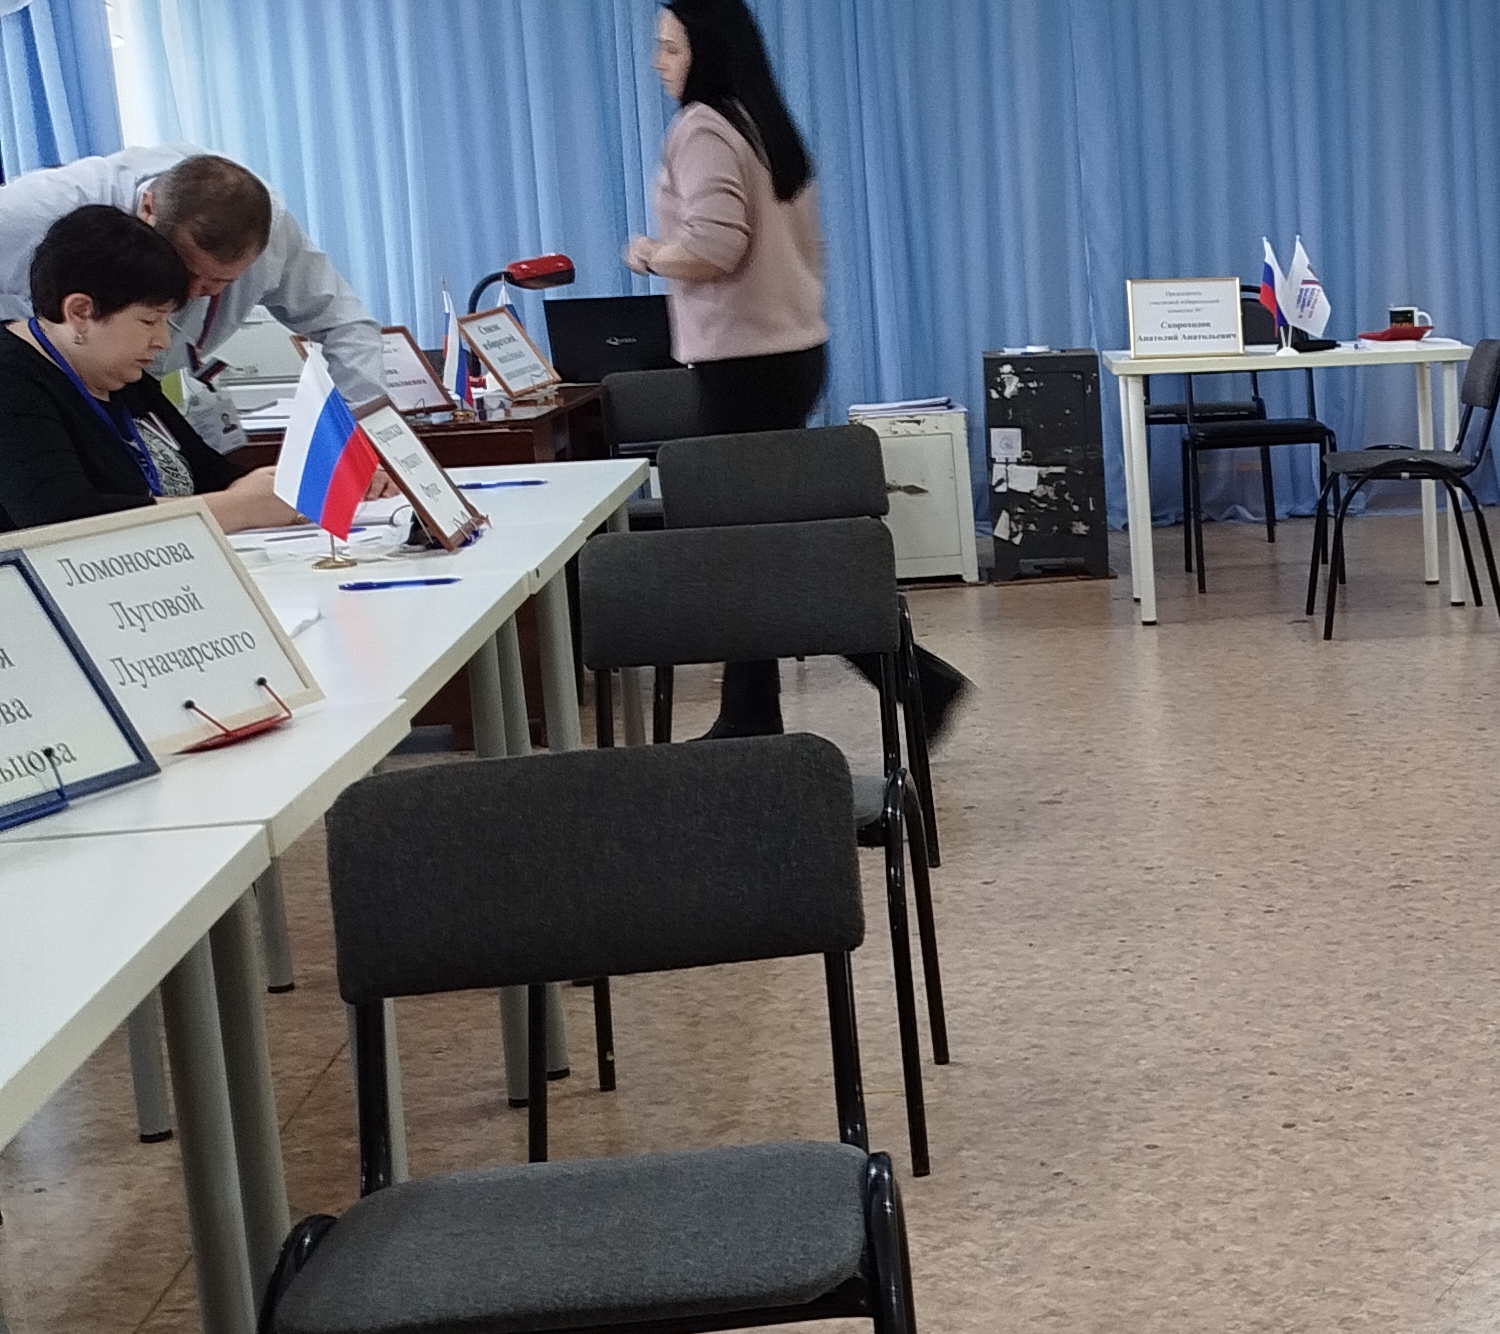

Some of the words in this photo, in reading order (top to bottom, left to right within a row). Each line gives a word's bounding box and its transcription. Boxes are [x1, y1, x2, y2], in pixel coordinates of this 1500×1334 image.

[58, 541, 195, 587] Ломоносова
[108, 585, 205, 634] Луговой
[110, 629, 257, 689] Луначарского
